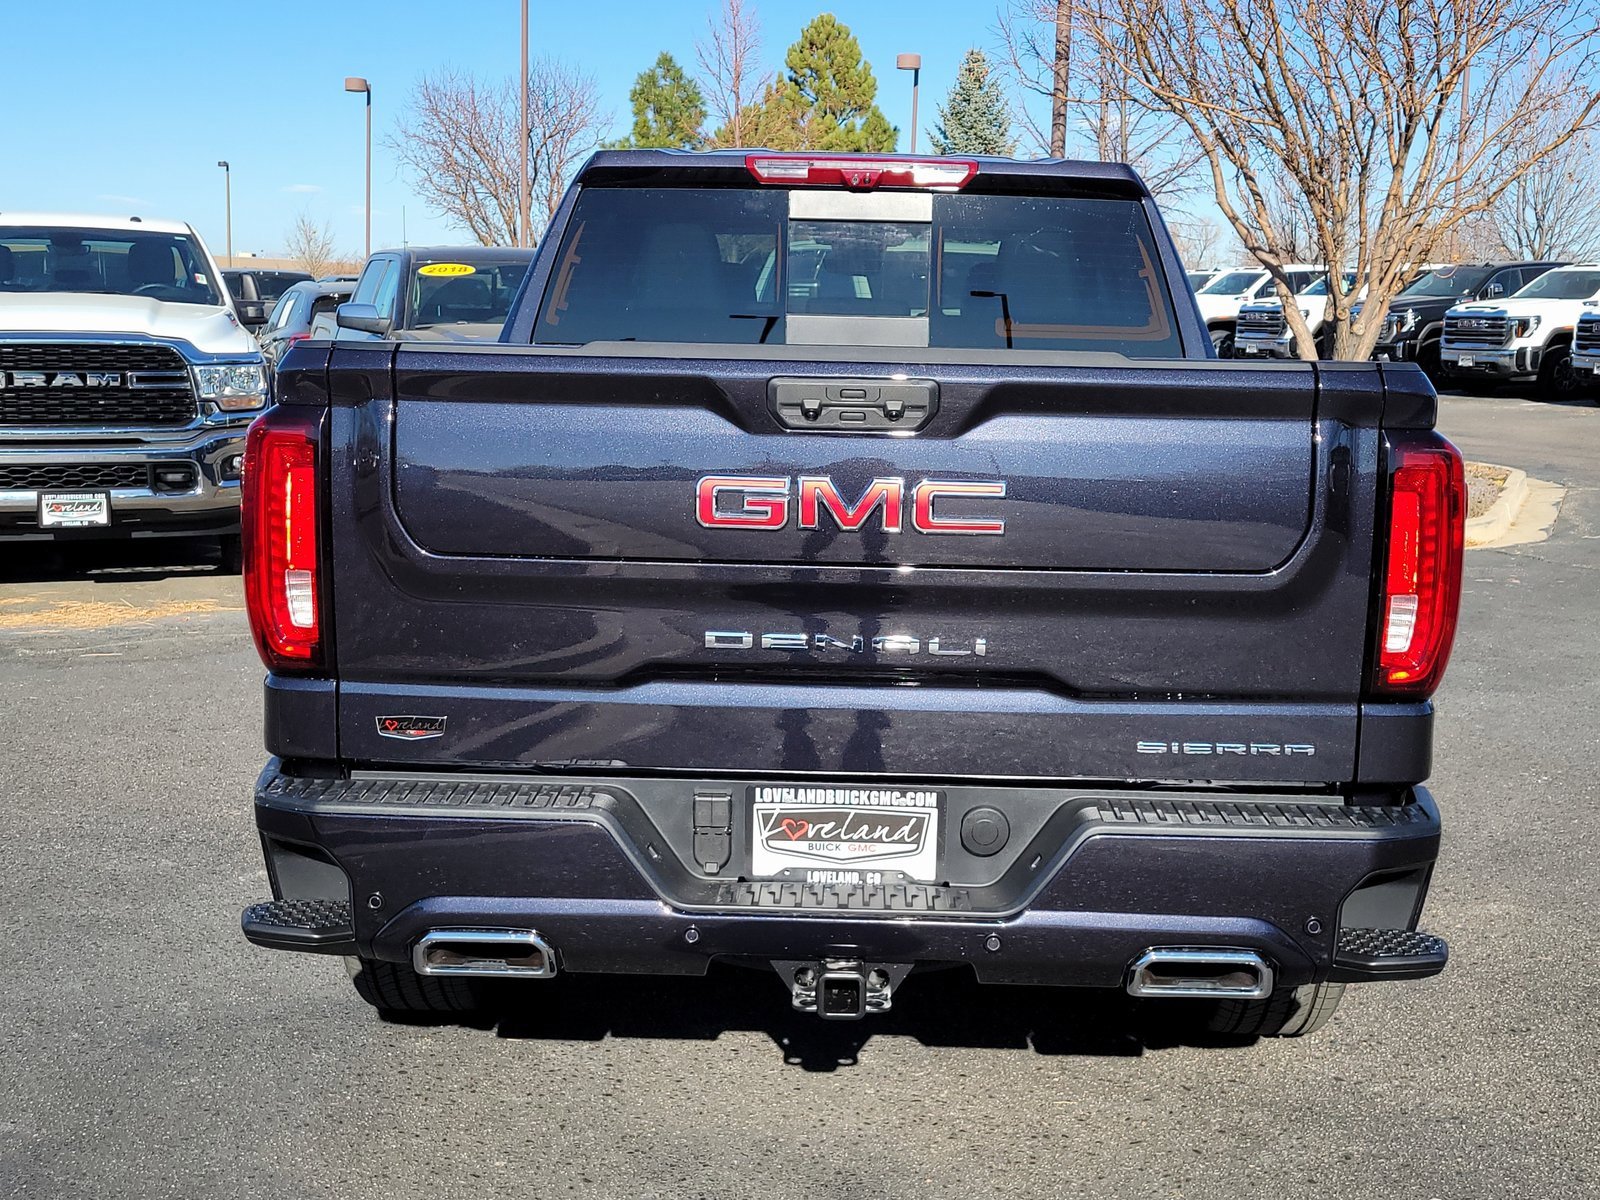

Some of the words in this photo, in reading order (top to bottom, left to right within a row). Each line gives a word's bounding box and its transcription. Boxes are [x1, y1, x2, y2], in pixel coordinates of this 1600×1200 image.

[13, 371, 121, 387] RAM
[696, 475, 1006, 535] GMC
[704, 631, 988, 656] DENALI
[1136, 741, 1315, 756] SIERRA
[755, 787, 937, 808] LOVELANDBUICKGMC.COM
[808, 843, 841, 852] BUICK
[848, 844, 877, 853] GMC
[866, 873, 881, 885] CO
